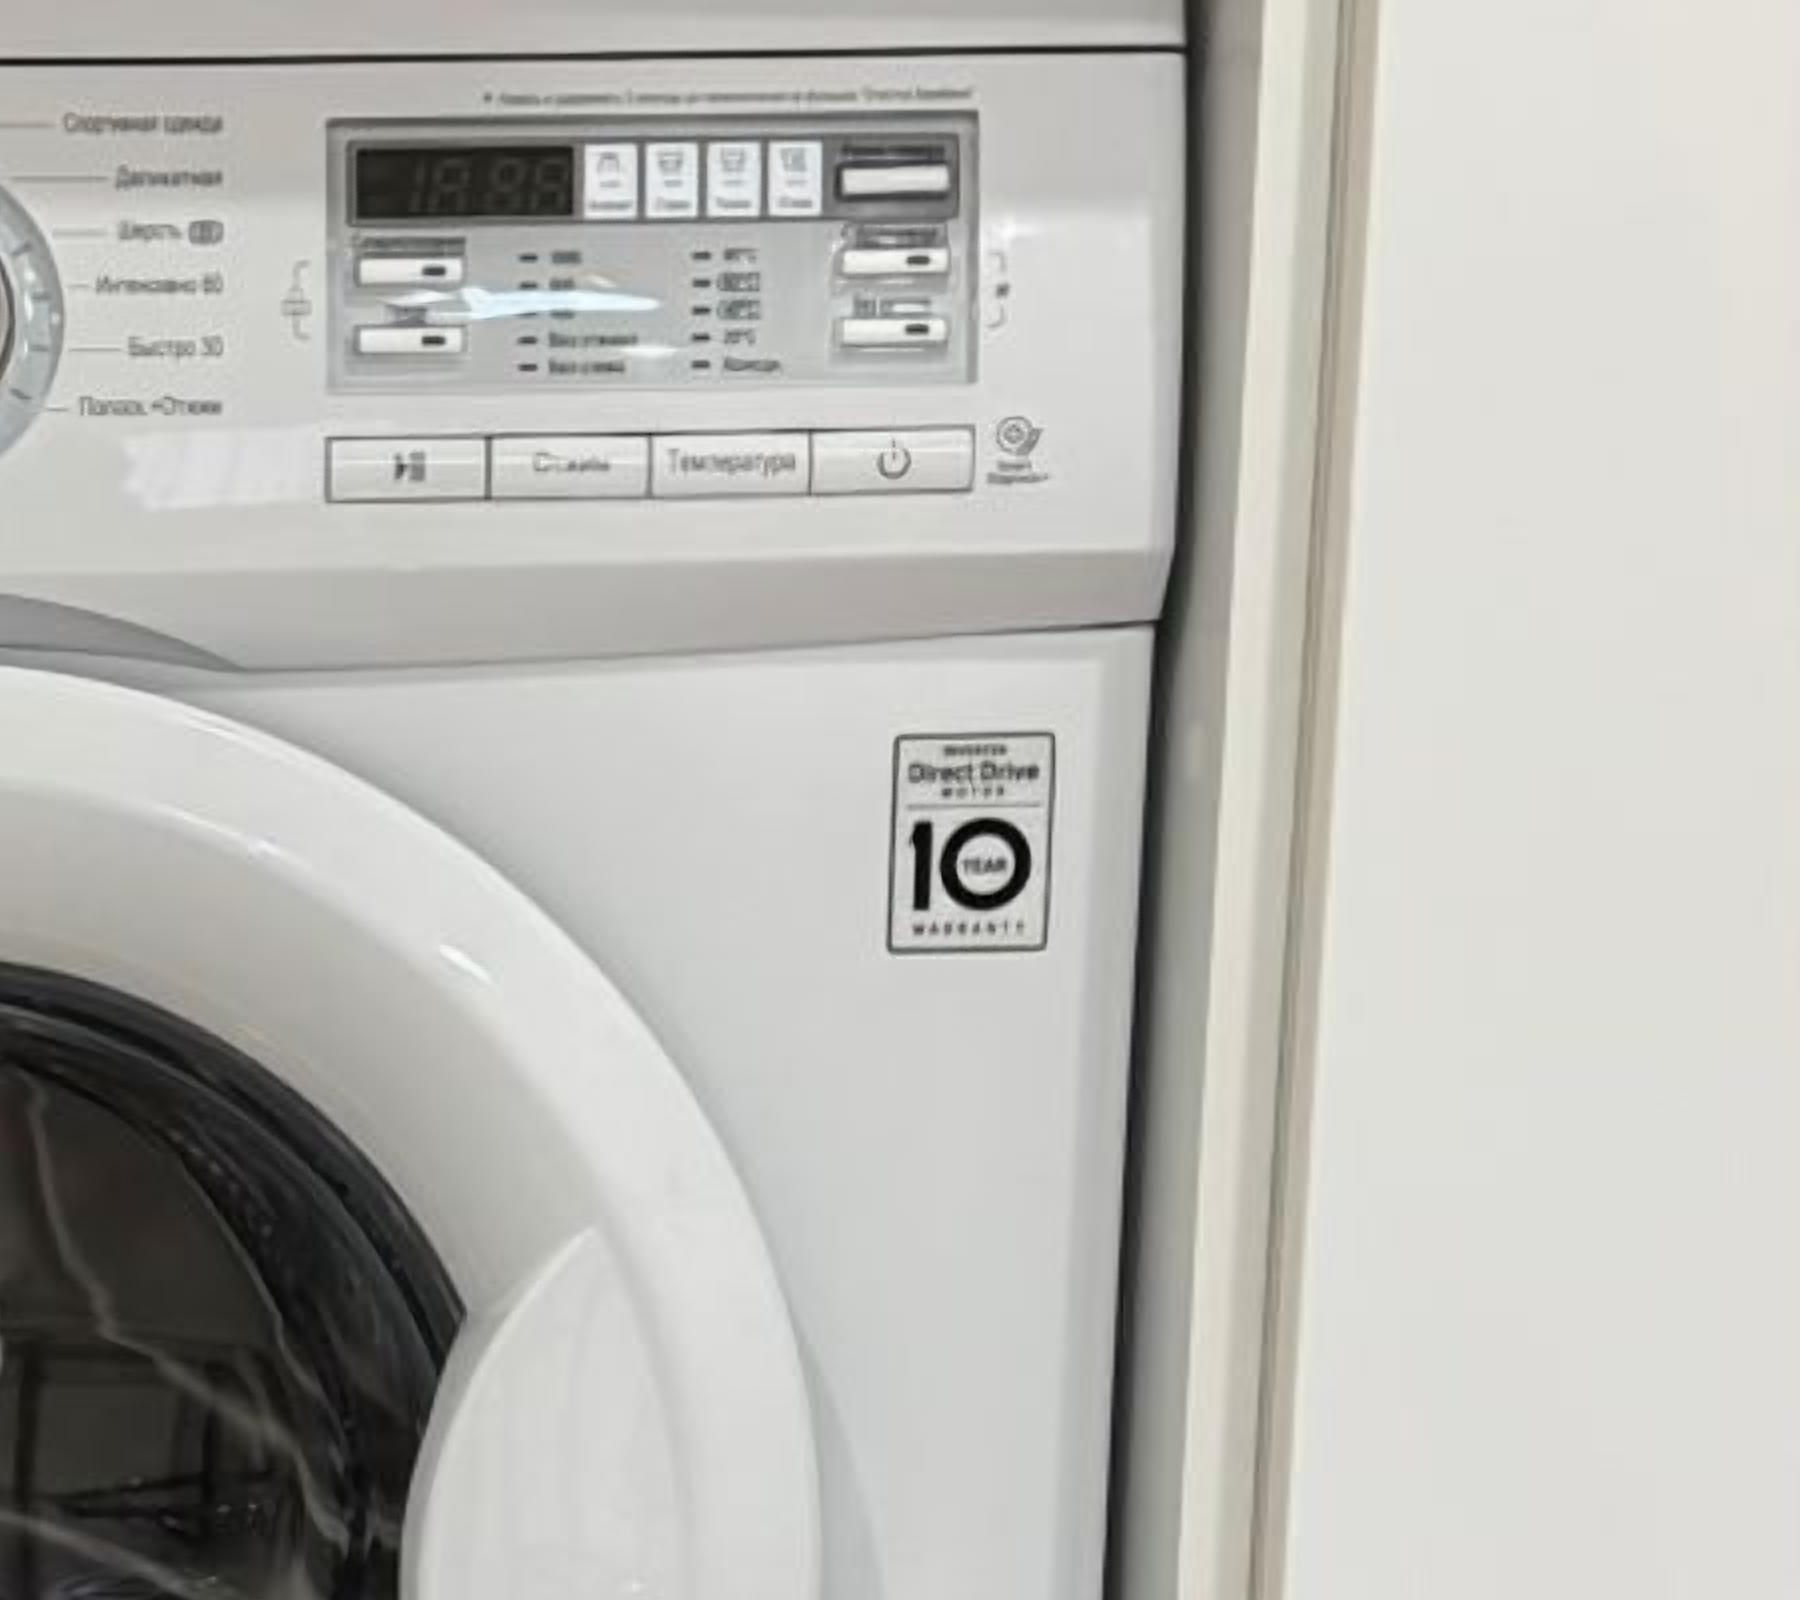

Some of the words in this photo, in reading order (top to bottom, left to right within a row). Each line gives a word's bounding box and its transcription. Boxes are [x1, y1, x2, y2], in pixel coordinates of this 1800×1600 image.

[128, 335, 196, 357] Быстро
[668, 448, 796, 477] Температура
[910, 817, 1032, 911] 10
